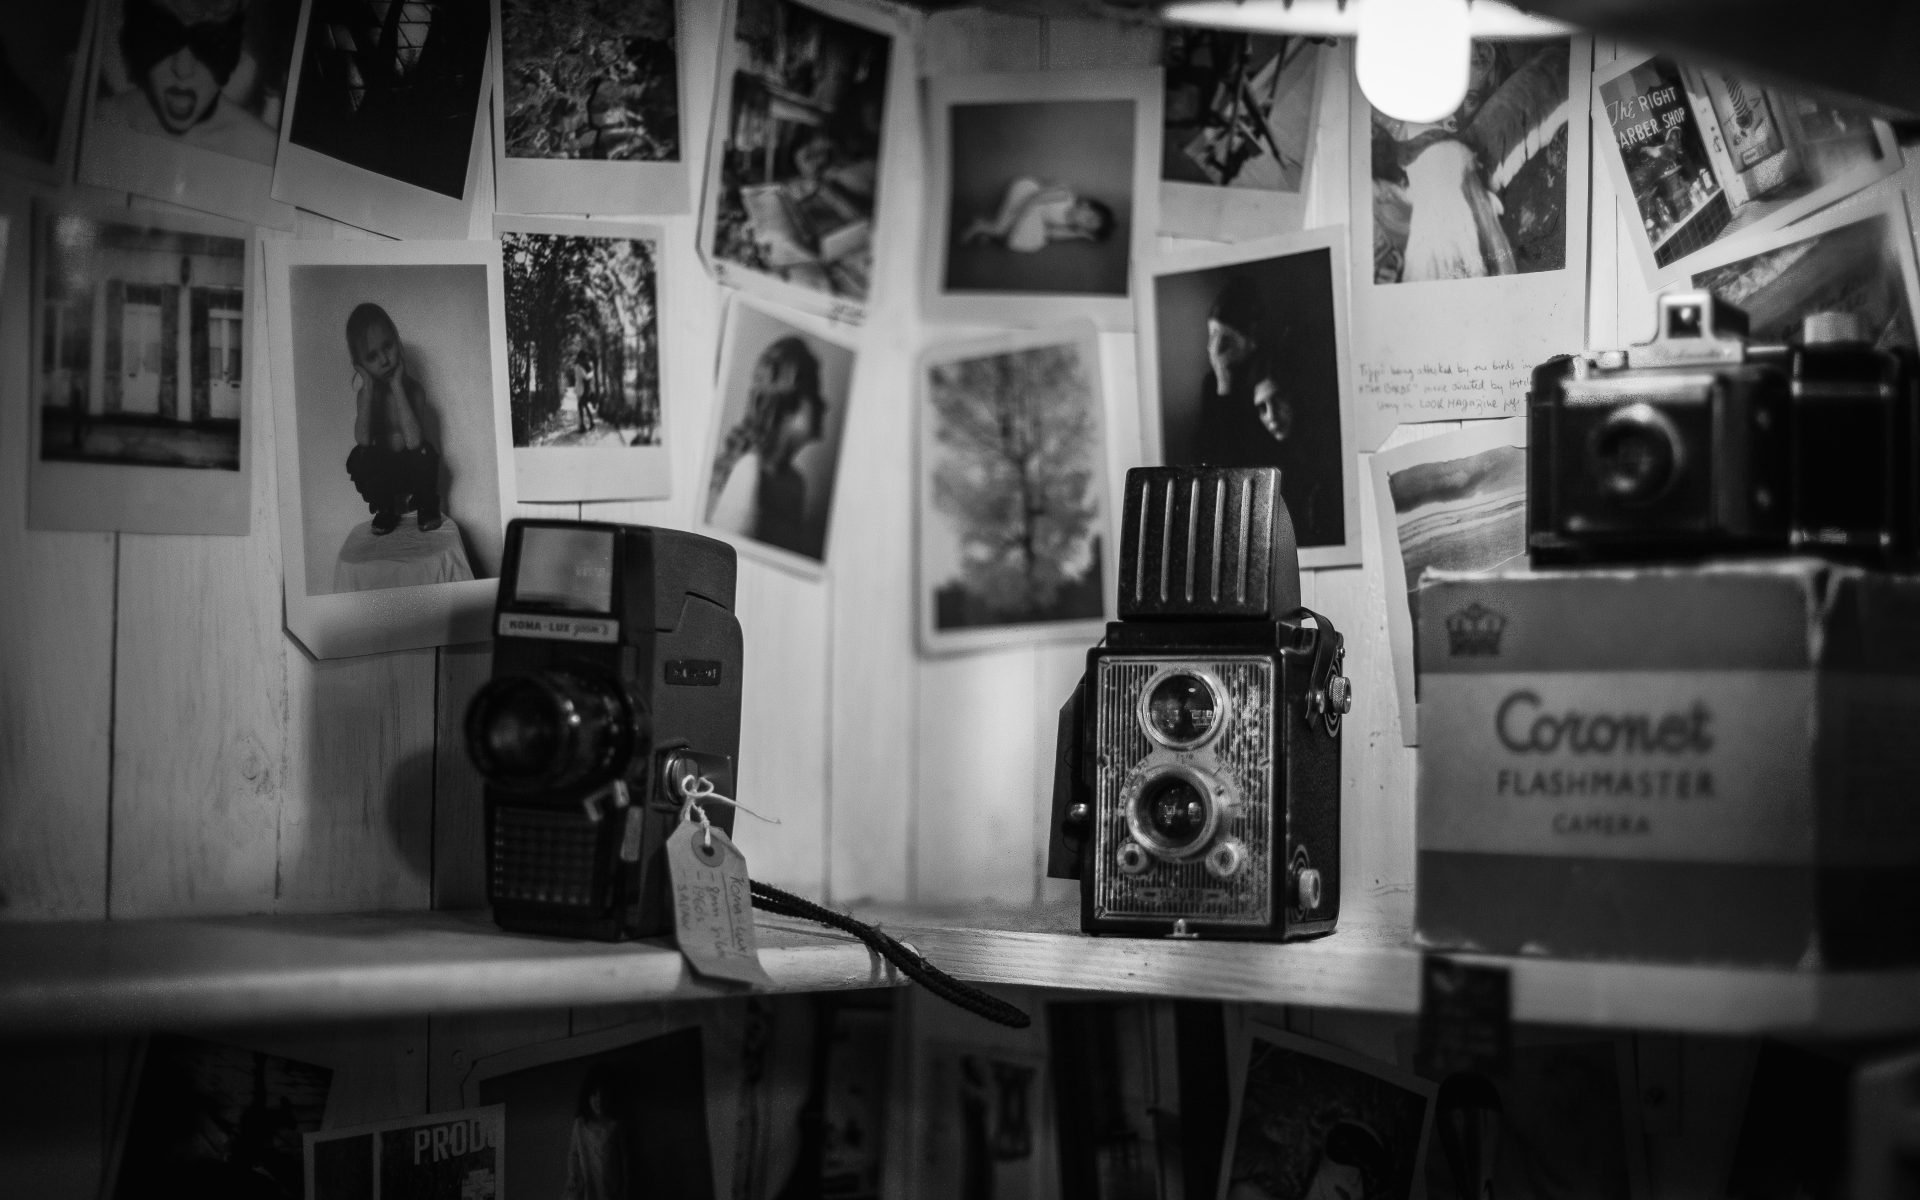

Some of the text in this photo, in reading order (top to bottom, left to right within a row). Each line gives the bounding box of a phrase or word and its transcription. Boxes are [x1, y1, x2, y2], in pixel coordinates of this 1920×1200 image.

[1638, 87, 1676, 112] RIGHT
[1618, 107, 1685, 149] ARBER SHOP
[1495, 688, 1716, 755] Coronet
[1497, 768, 1716, 800] FLASHMASTER
[1551, 814, 1651, 838] CAMERA
